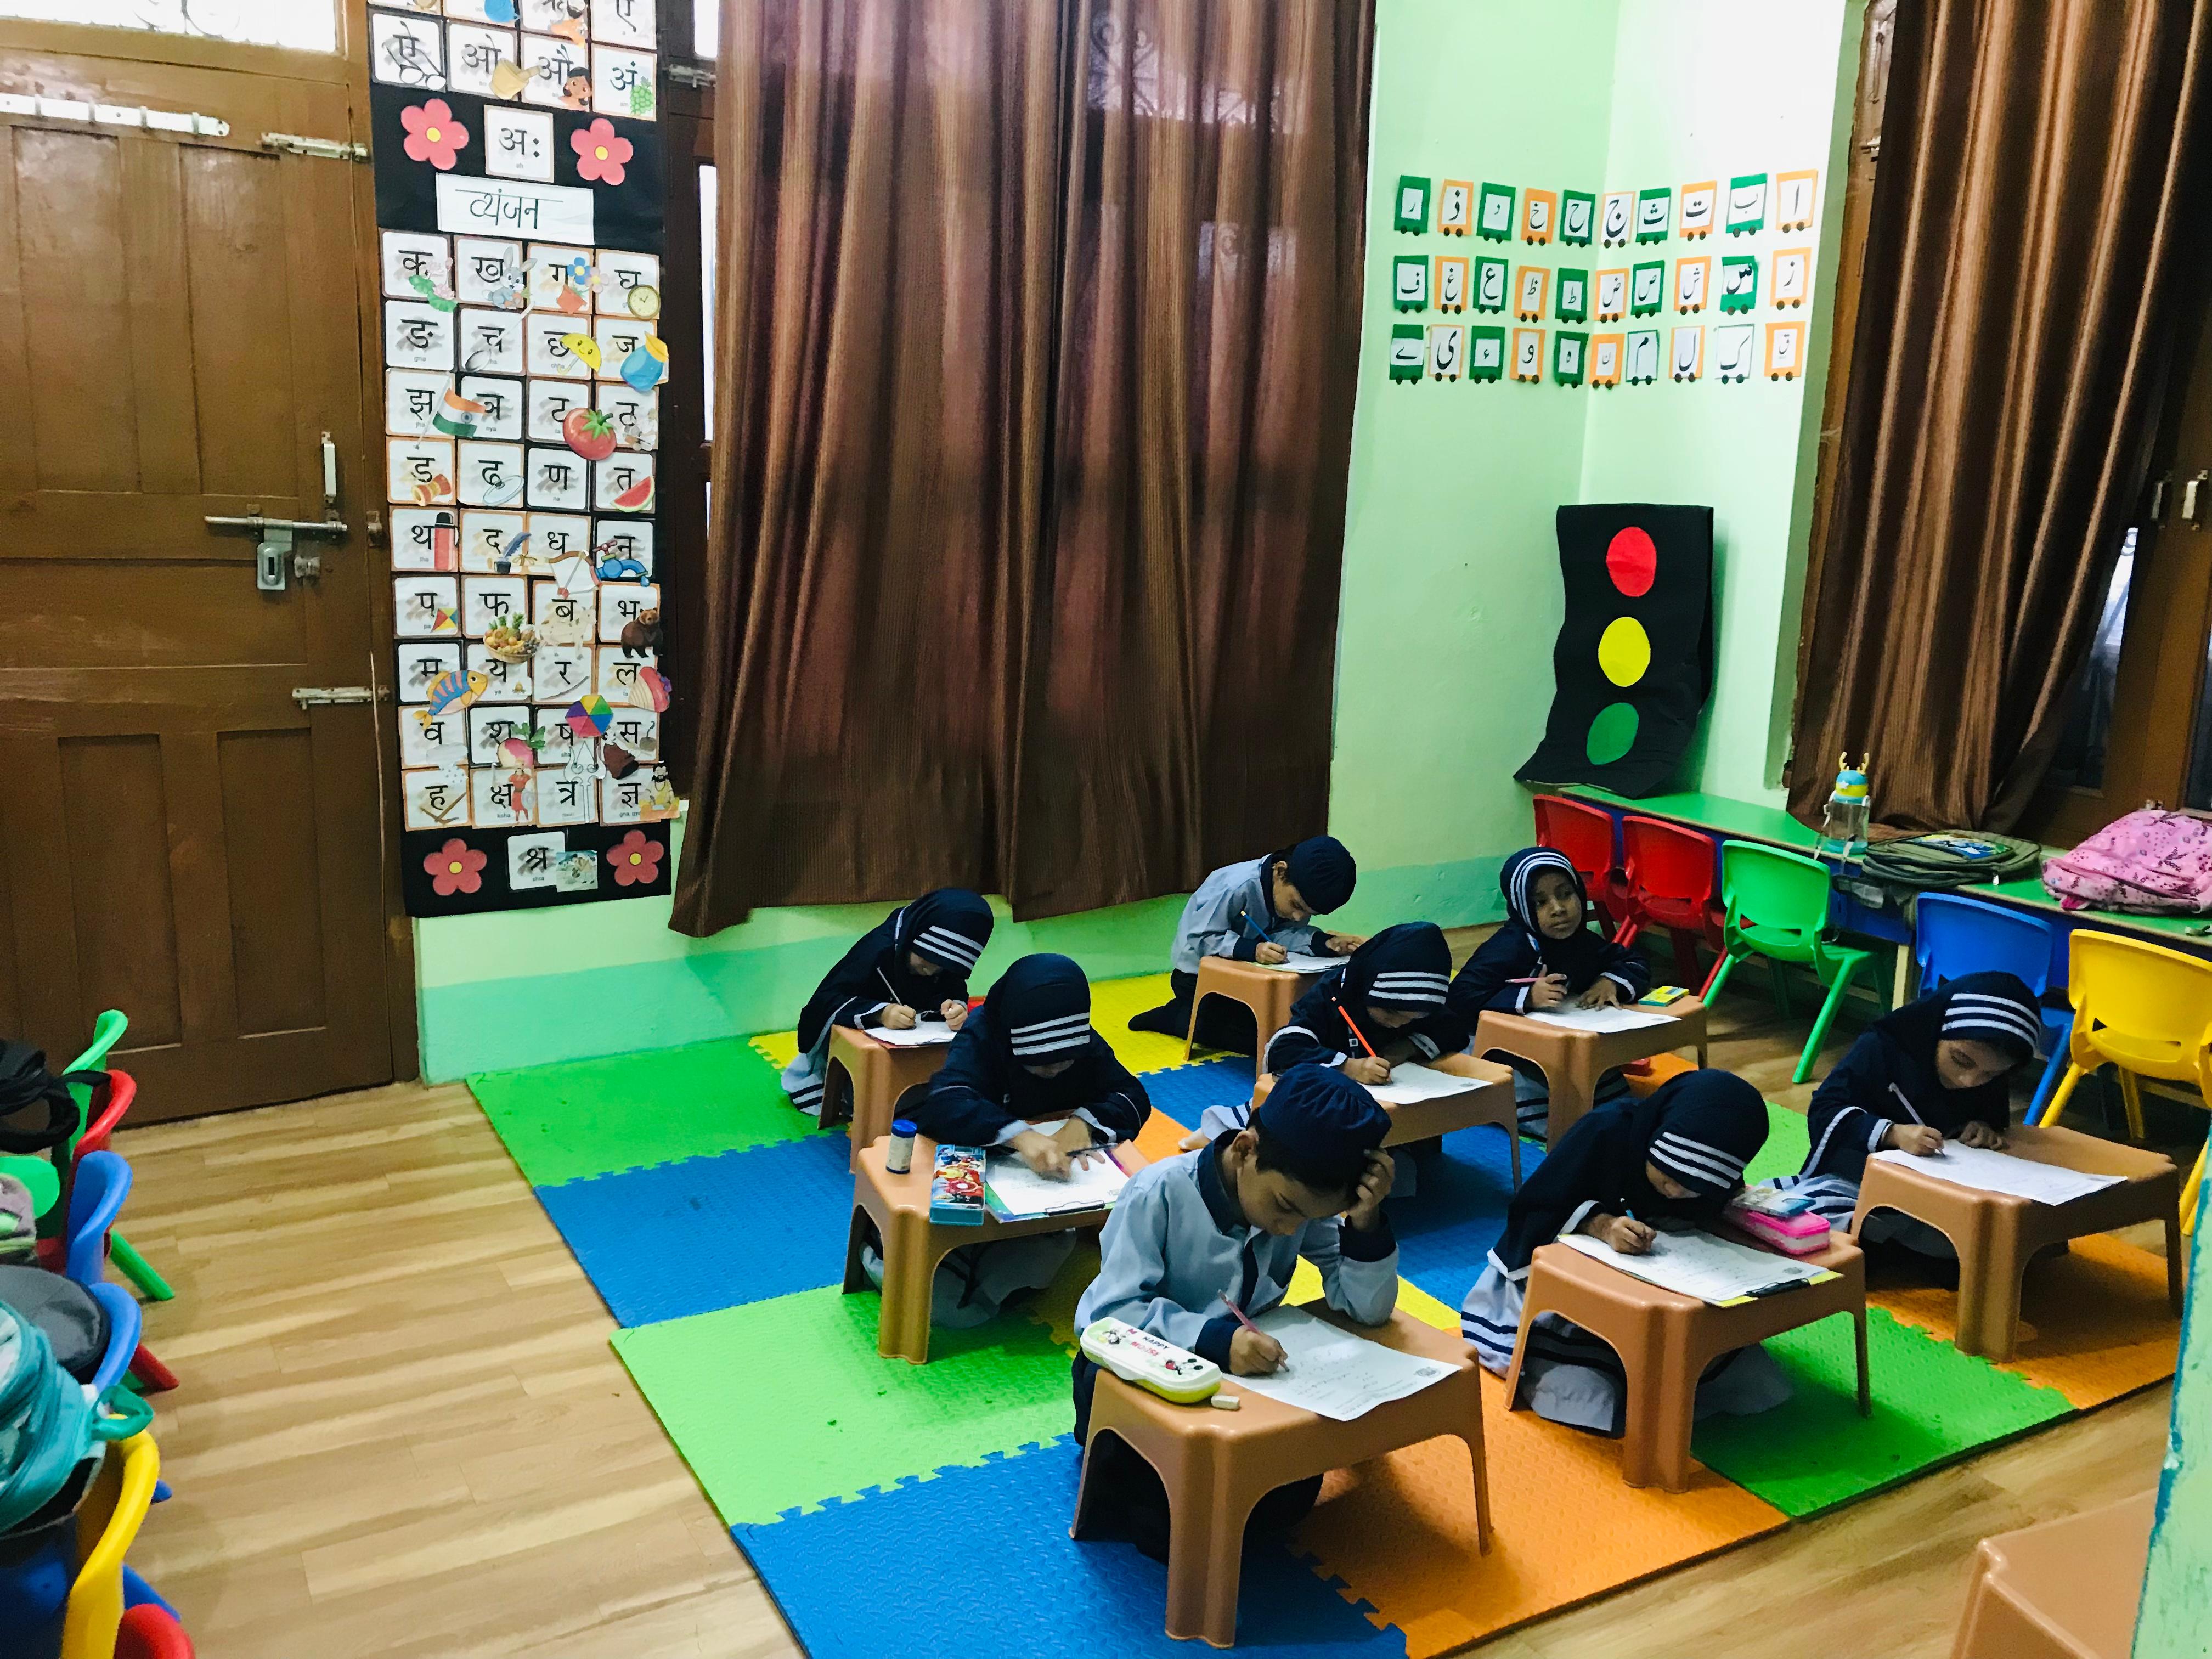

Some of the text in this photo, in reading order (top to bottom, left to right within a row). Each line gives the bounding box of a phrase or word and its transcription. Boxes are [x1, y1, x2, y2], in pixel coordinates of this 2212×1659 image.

[610, 61, 638, 90] अं
[499, 128, 540, 158] अः
[455, 188, 563, 229] व्यंजन
[1530, 203, 1545, 229] خ
[1644, 204, 1666, 225] ث
[1686, 200, 1708, 217] ت
[1734, 193, 1758, 214] ب
[1569, 204, 1585, 233] ح
[1606, 199, 1628, 238] ج
[398, 250, 433, 276] क
[471, 256, 504, 283] ख
[1401, 261, 1795, 307] ز س ش ص ض ط ظ ع غ ف
[478, 326, 505, 352] च
[544, 331, 570, 357] छ
[612, 336, 638, 353] ज
[1522, 344, 1534, 364] و
[1635, 337, 1649, 373] م
[1679, 332, 1697, 371] ل
[405, 389, 435, 420] झ
[549, 397, 569, 421] ट
[544, 465, 571, 490] ण
[614, 468, 635, 491] त
[411, 525, 635, 560] थ द ध न
[415, 592, 641, 622] प फ ब भ
[486, 659, 507, 682] य
[555, 662, 571, 684] र
[613, 663, 641, 685] ल
[420, 721, 444, 744] व
[486, 721, 515, 746] श
[617, 721, 641, 744] स
[425, 785, 448, 810] ह
[1143, 1336, 1170, 1349] HAPPY
